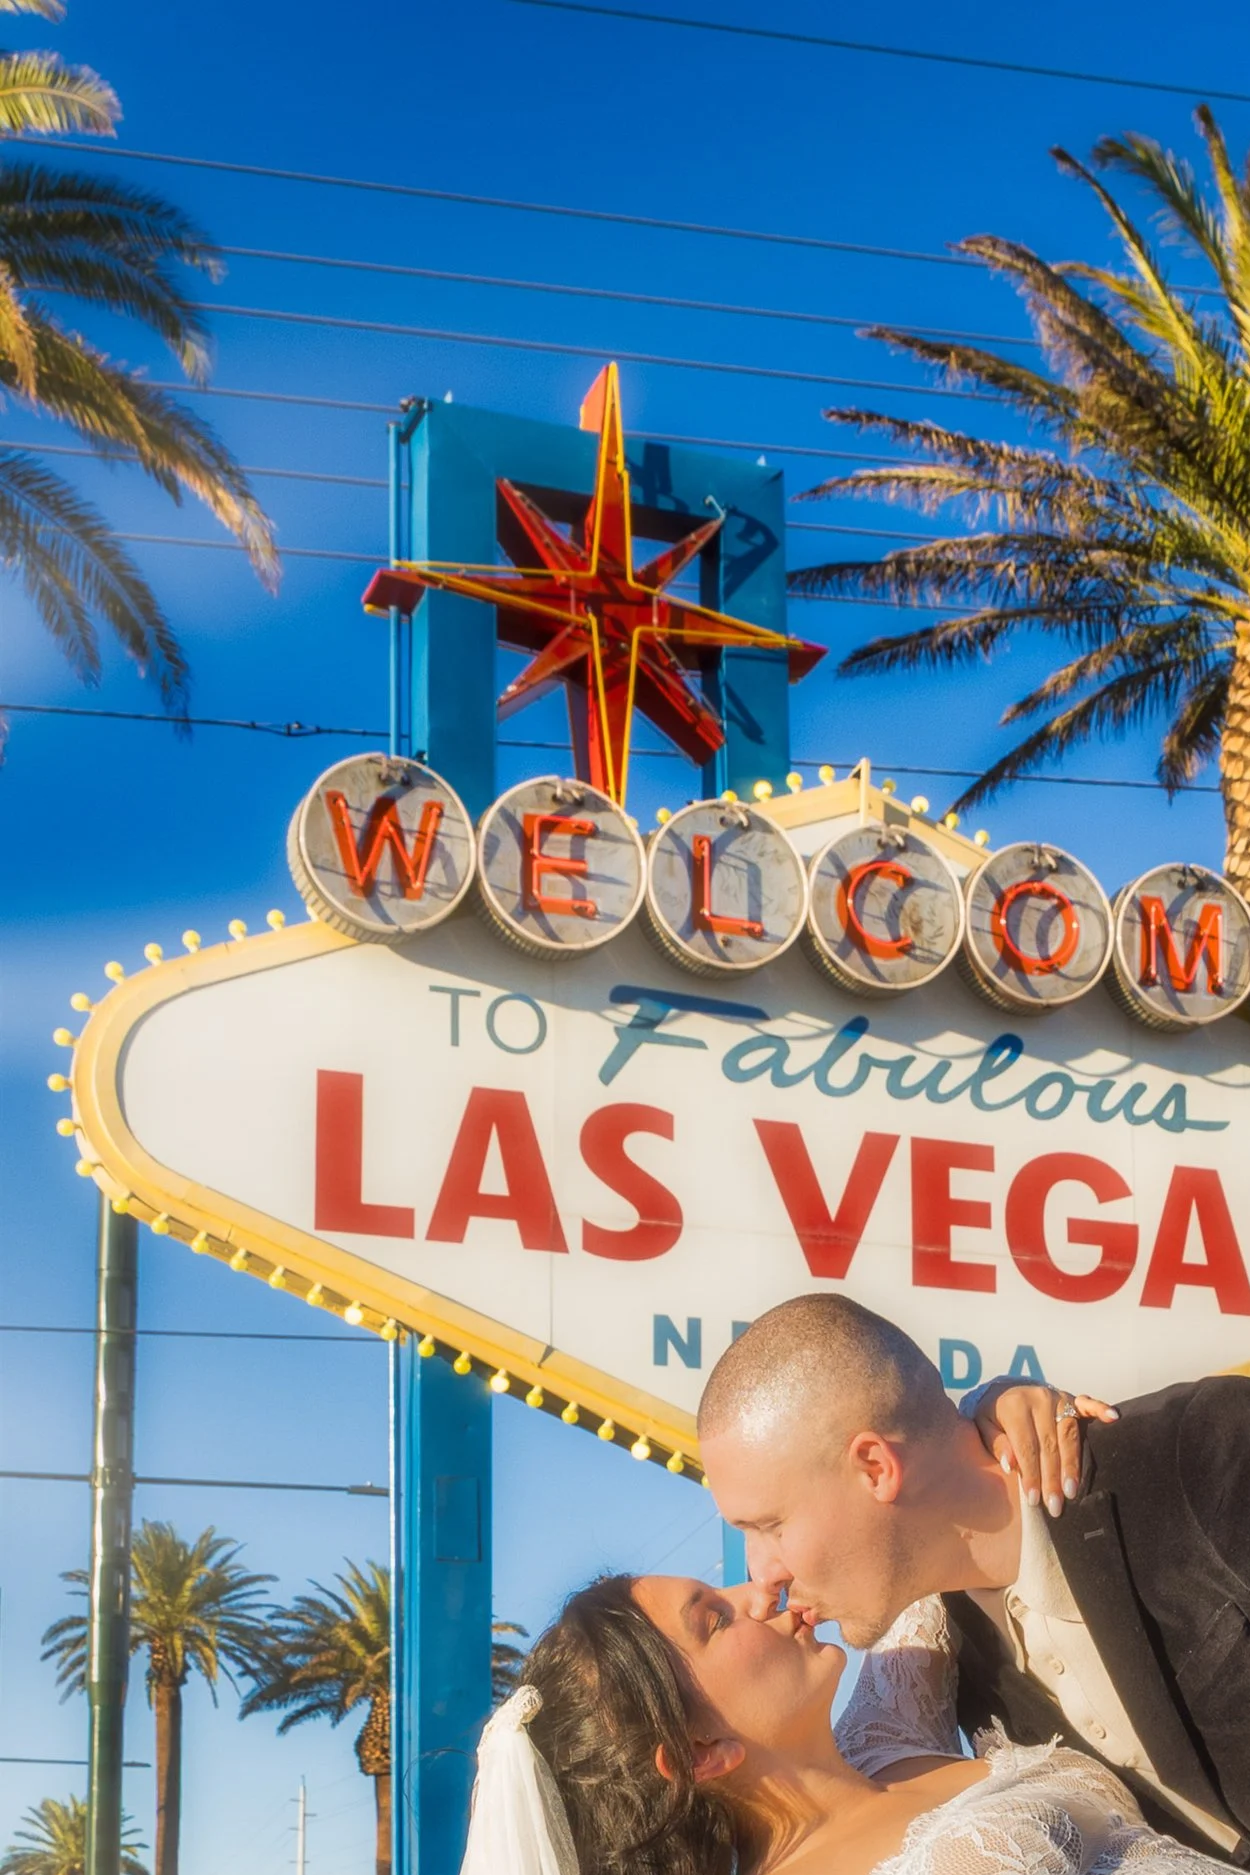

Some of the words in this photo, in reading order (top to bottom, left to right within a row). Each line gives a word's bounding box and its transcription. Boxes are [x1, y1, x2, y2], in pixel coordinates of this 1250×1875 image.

[428, 984, 549, 1055] TO
[597, 983, 1232, 1134] Fabulous
[314, 1068, 684, 1262] LAS
[652, 1313, 1048, 1390] NDA
